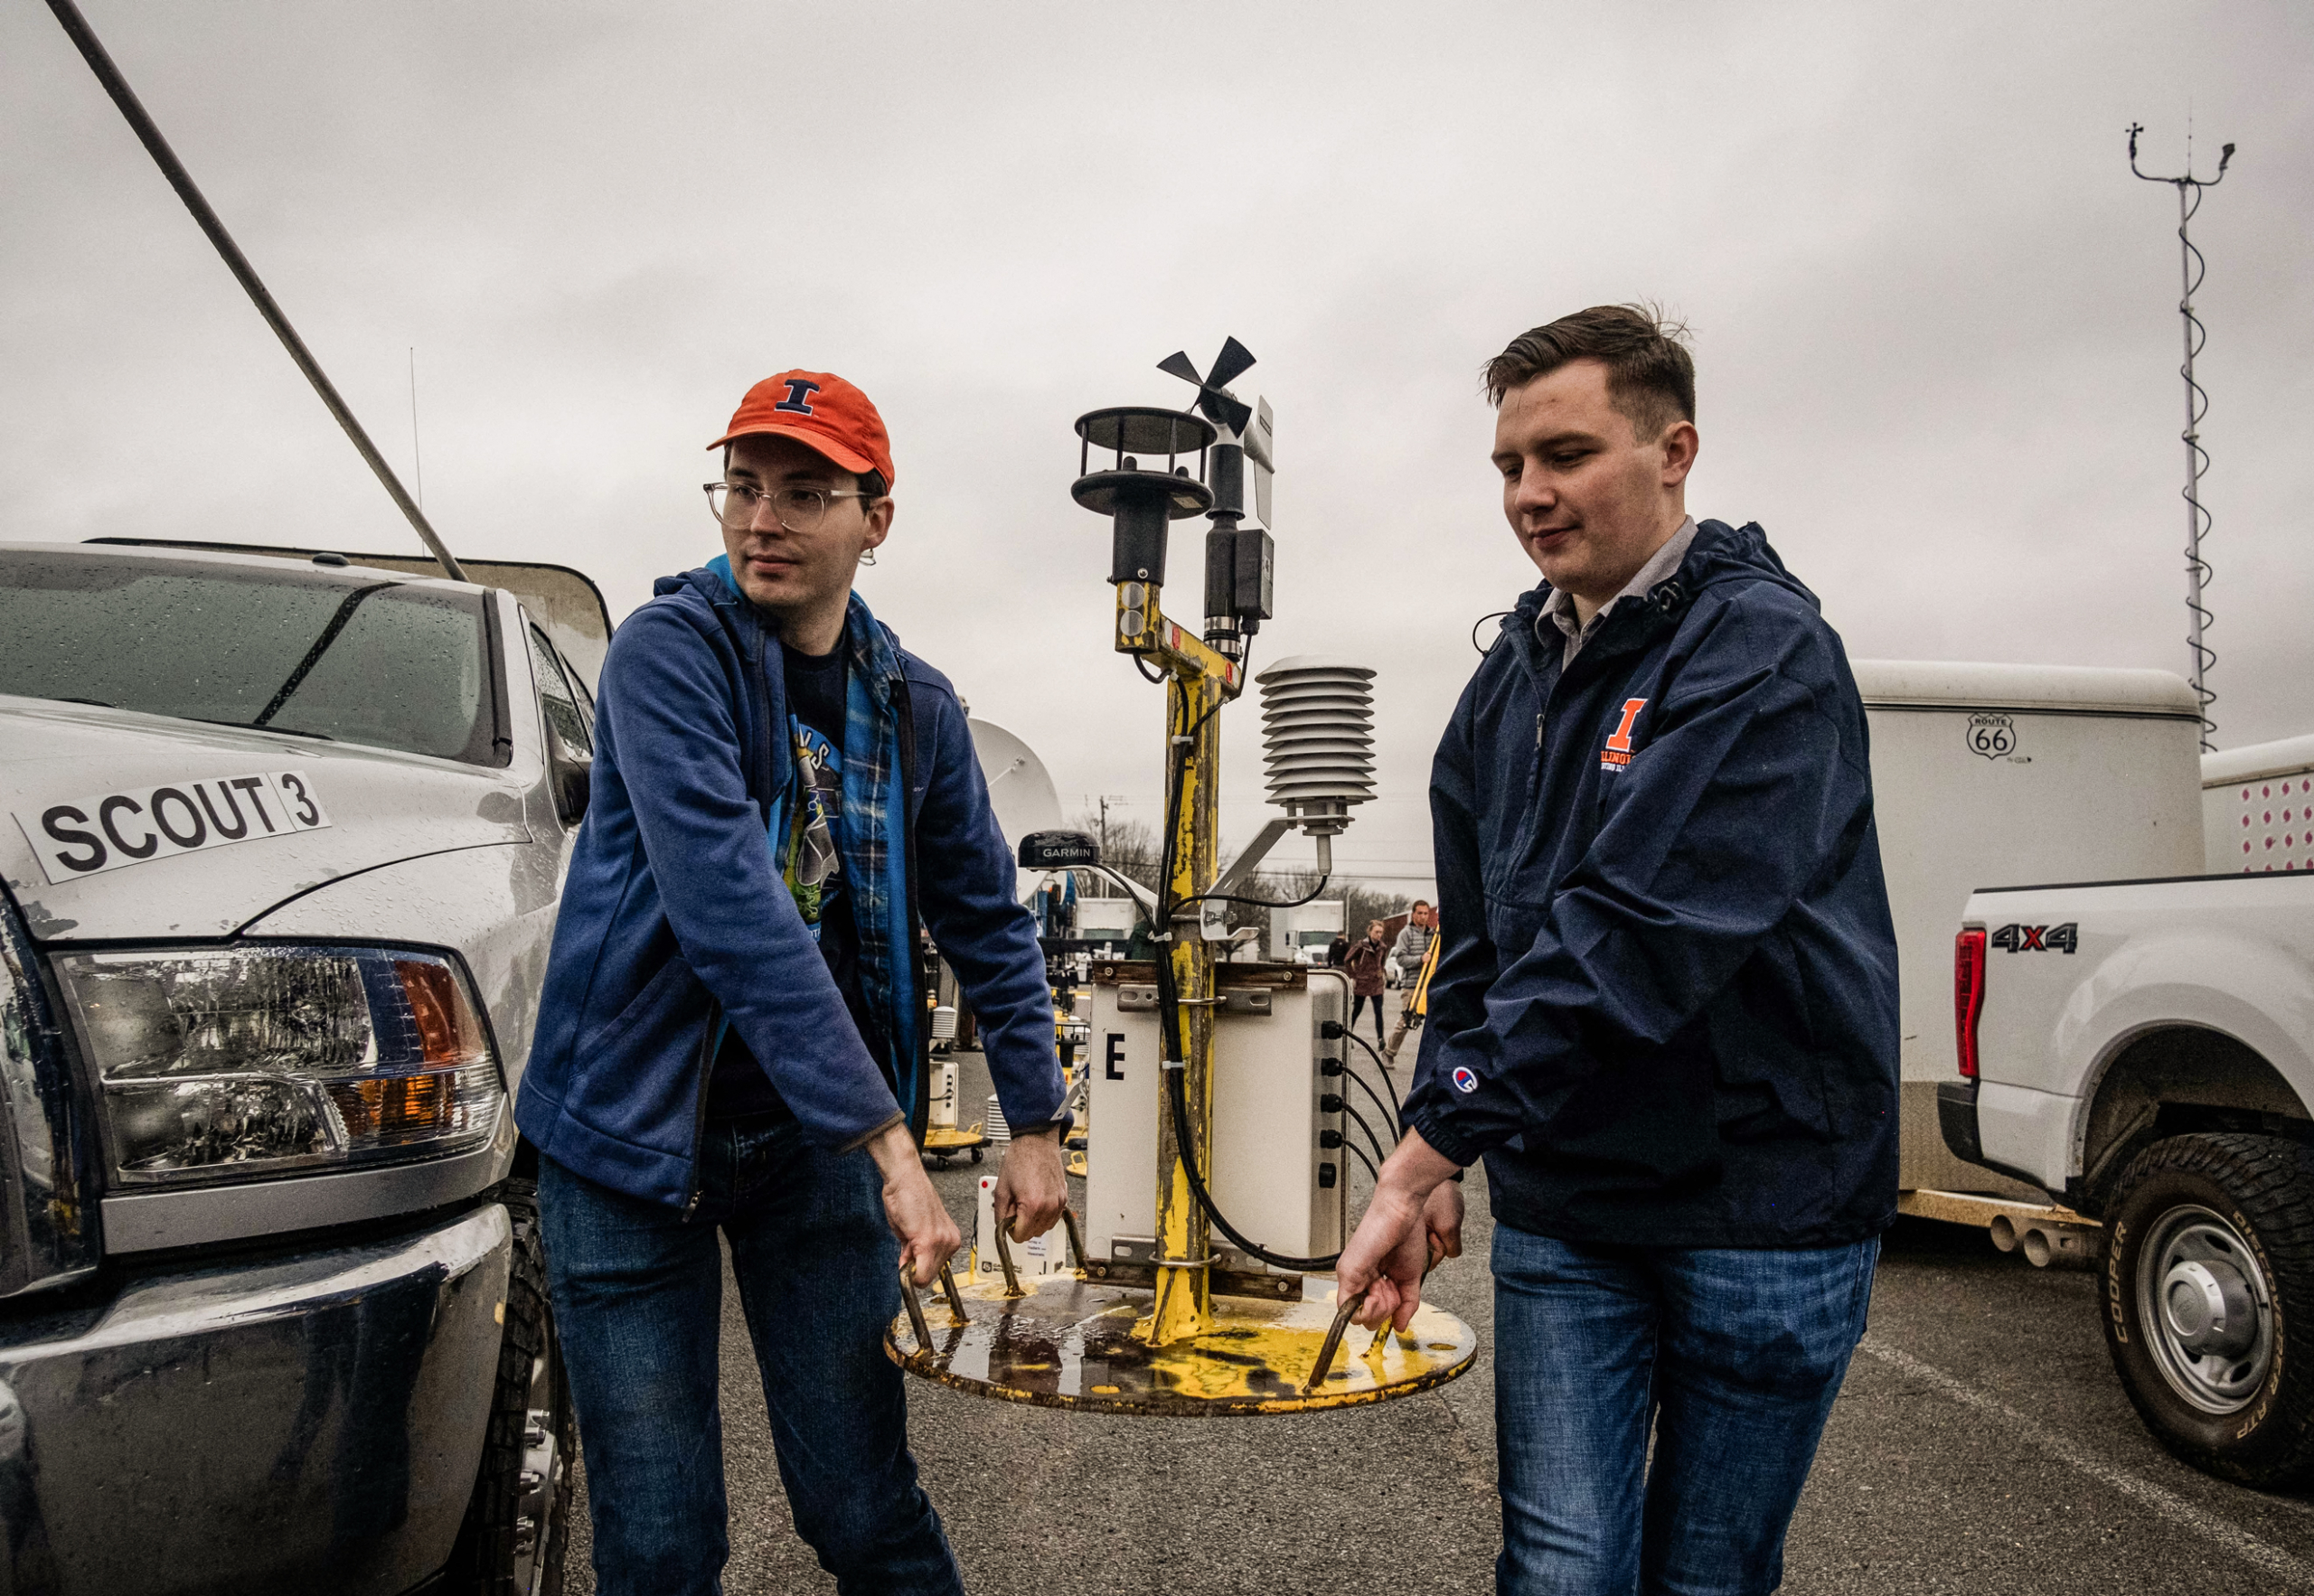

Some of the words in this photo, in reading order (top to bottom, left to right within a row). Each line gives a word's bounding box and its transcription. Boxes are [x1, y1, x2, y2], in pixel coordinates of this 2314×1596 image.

[774, 379, 821, 417] I
[1605, 698, 1649, 752] I
[1975, 728, 2008, 751] 66
[42, 777, 276, 872] SCOUT
[281, 773, 320, 826] 3
[1042, 848, 1091, 858] GARMIN
[1105, 1033, 1125, 1080] E
[2109, 1221, 2128, 1343] COOPER
